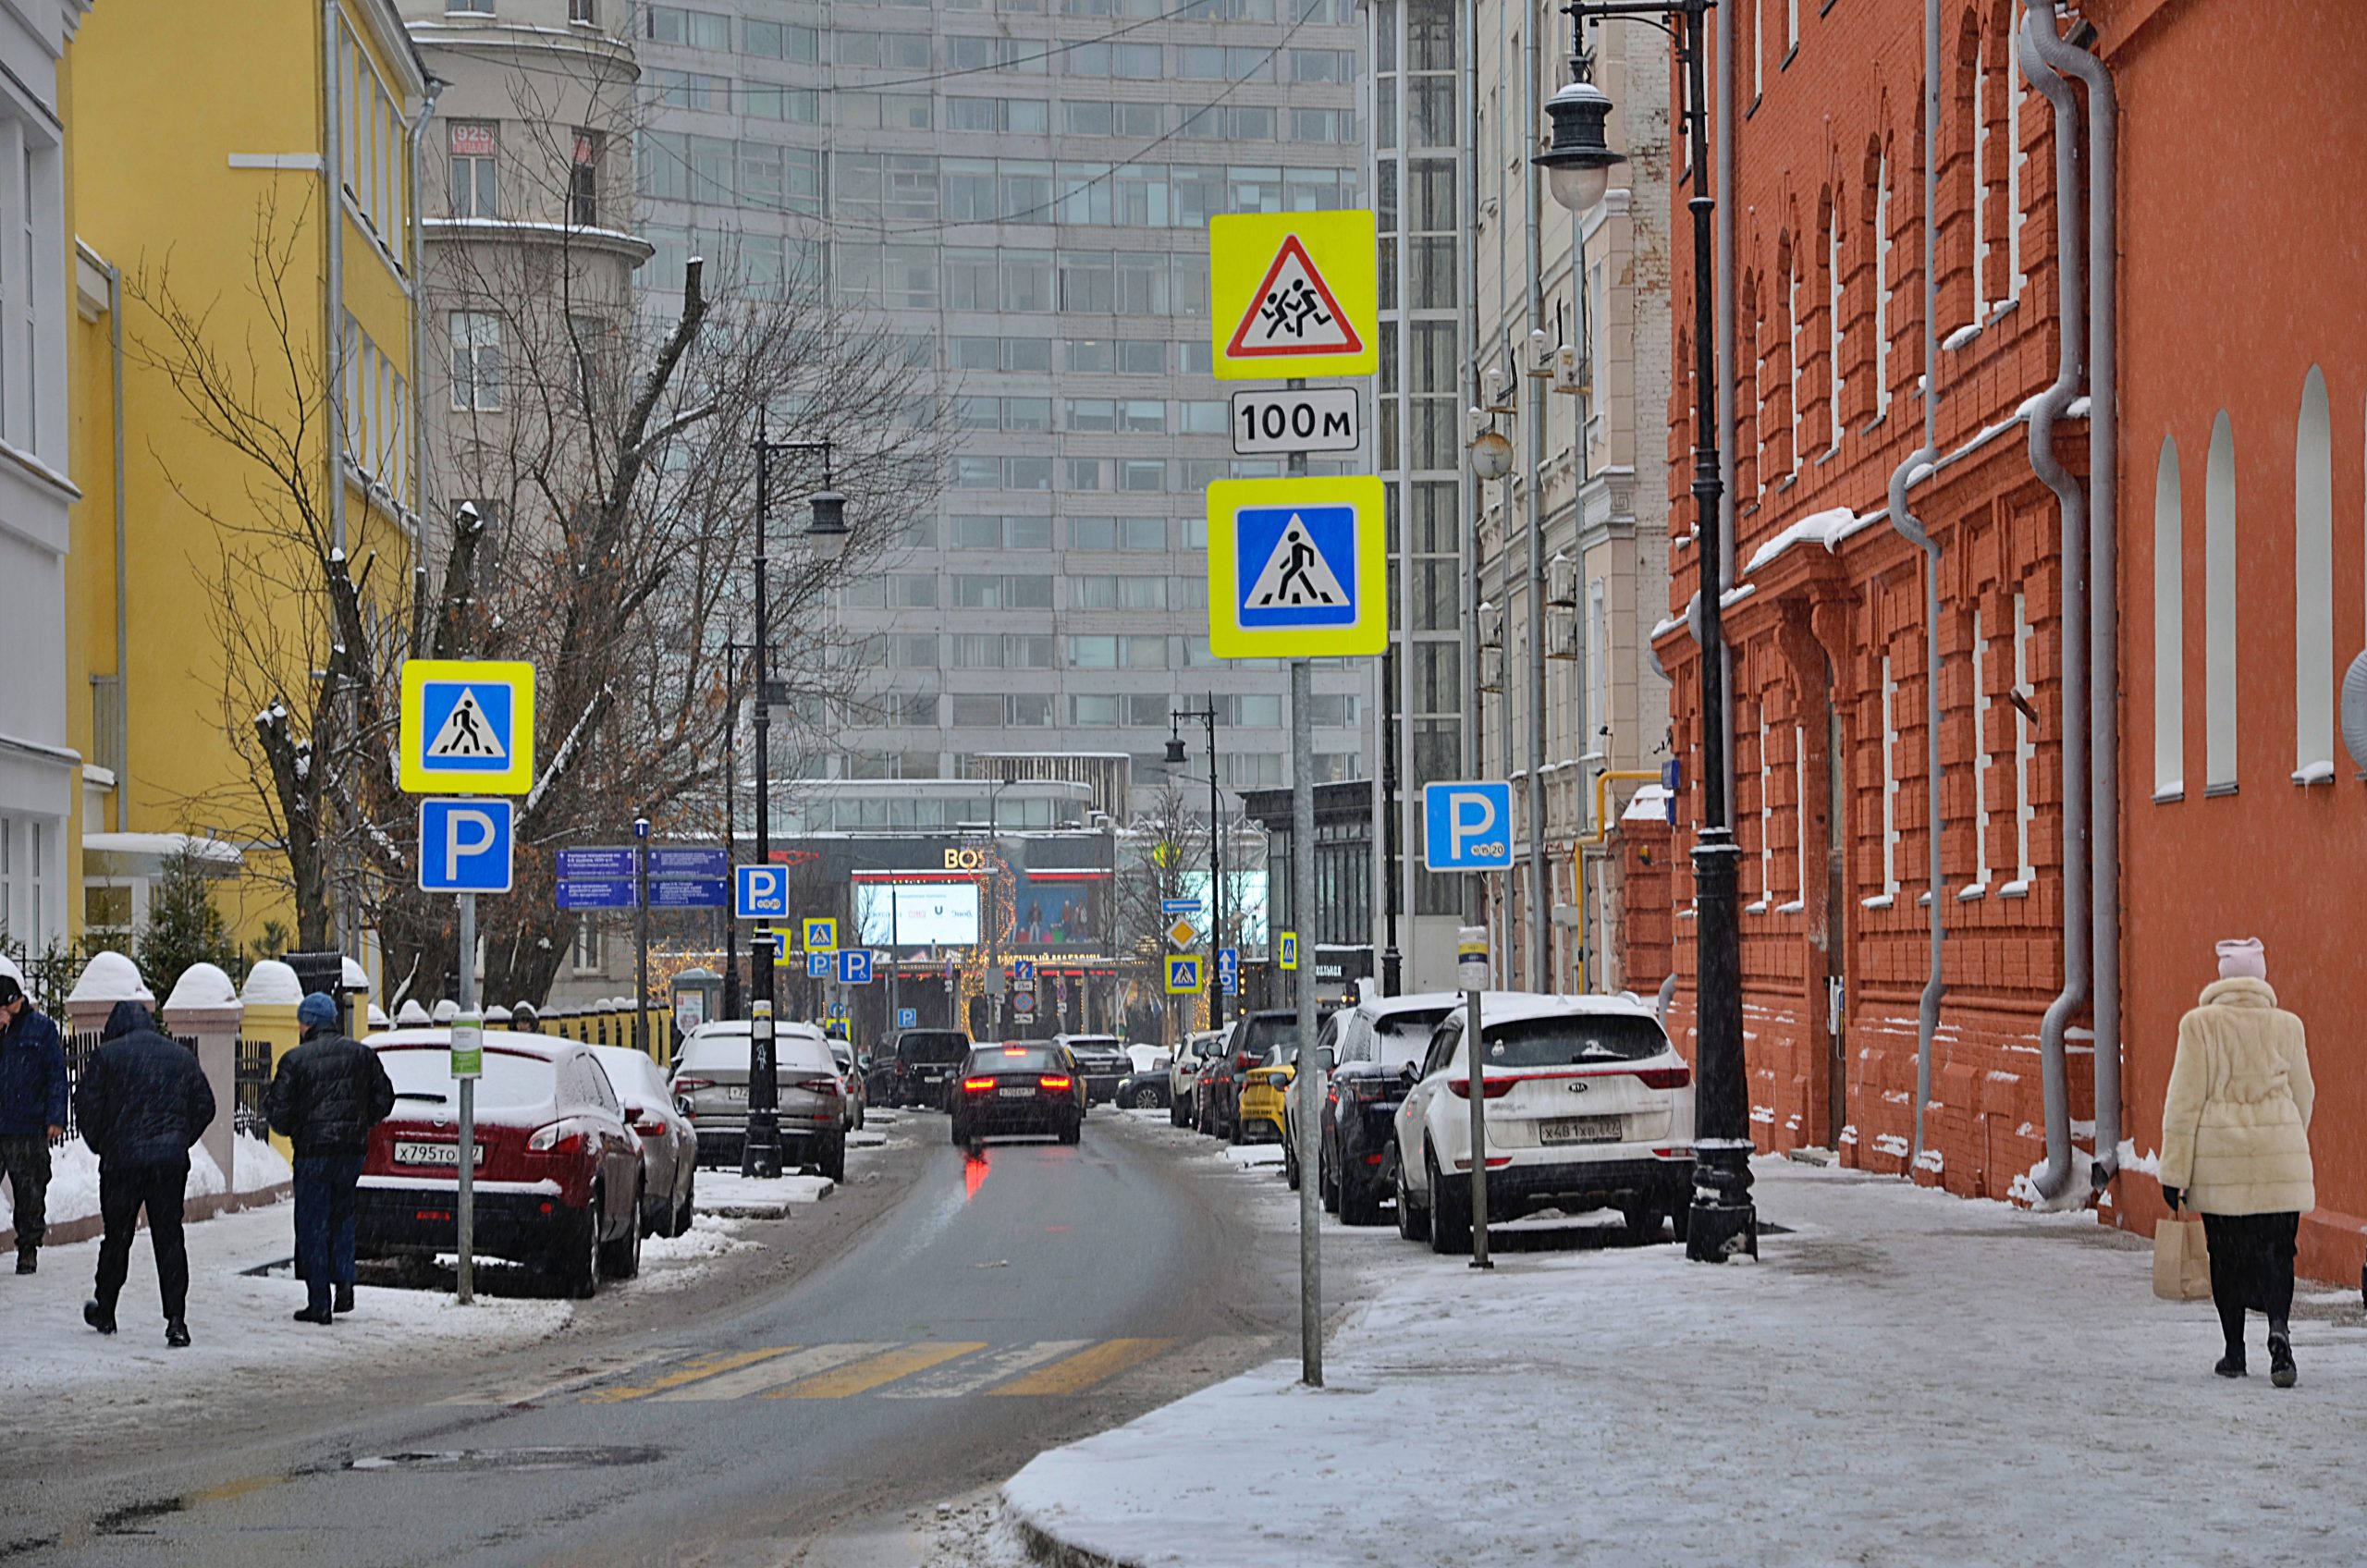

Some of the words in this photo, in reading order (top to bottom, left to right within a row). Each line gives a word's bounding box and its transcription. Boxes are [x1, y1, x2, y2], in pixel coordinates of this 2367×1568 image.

[1449, 792, 1495, 860] P
[446, 809, 496, 881] P
[748, 870, 777, 911] P
[815, 956, 828, 974] P
[847, 953, 866, 980] P
[902, 1011, 913, 1024] P
[1572, 1084, 1586, 1092] KIA
